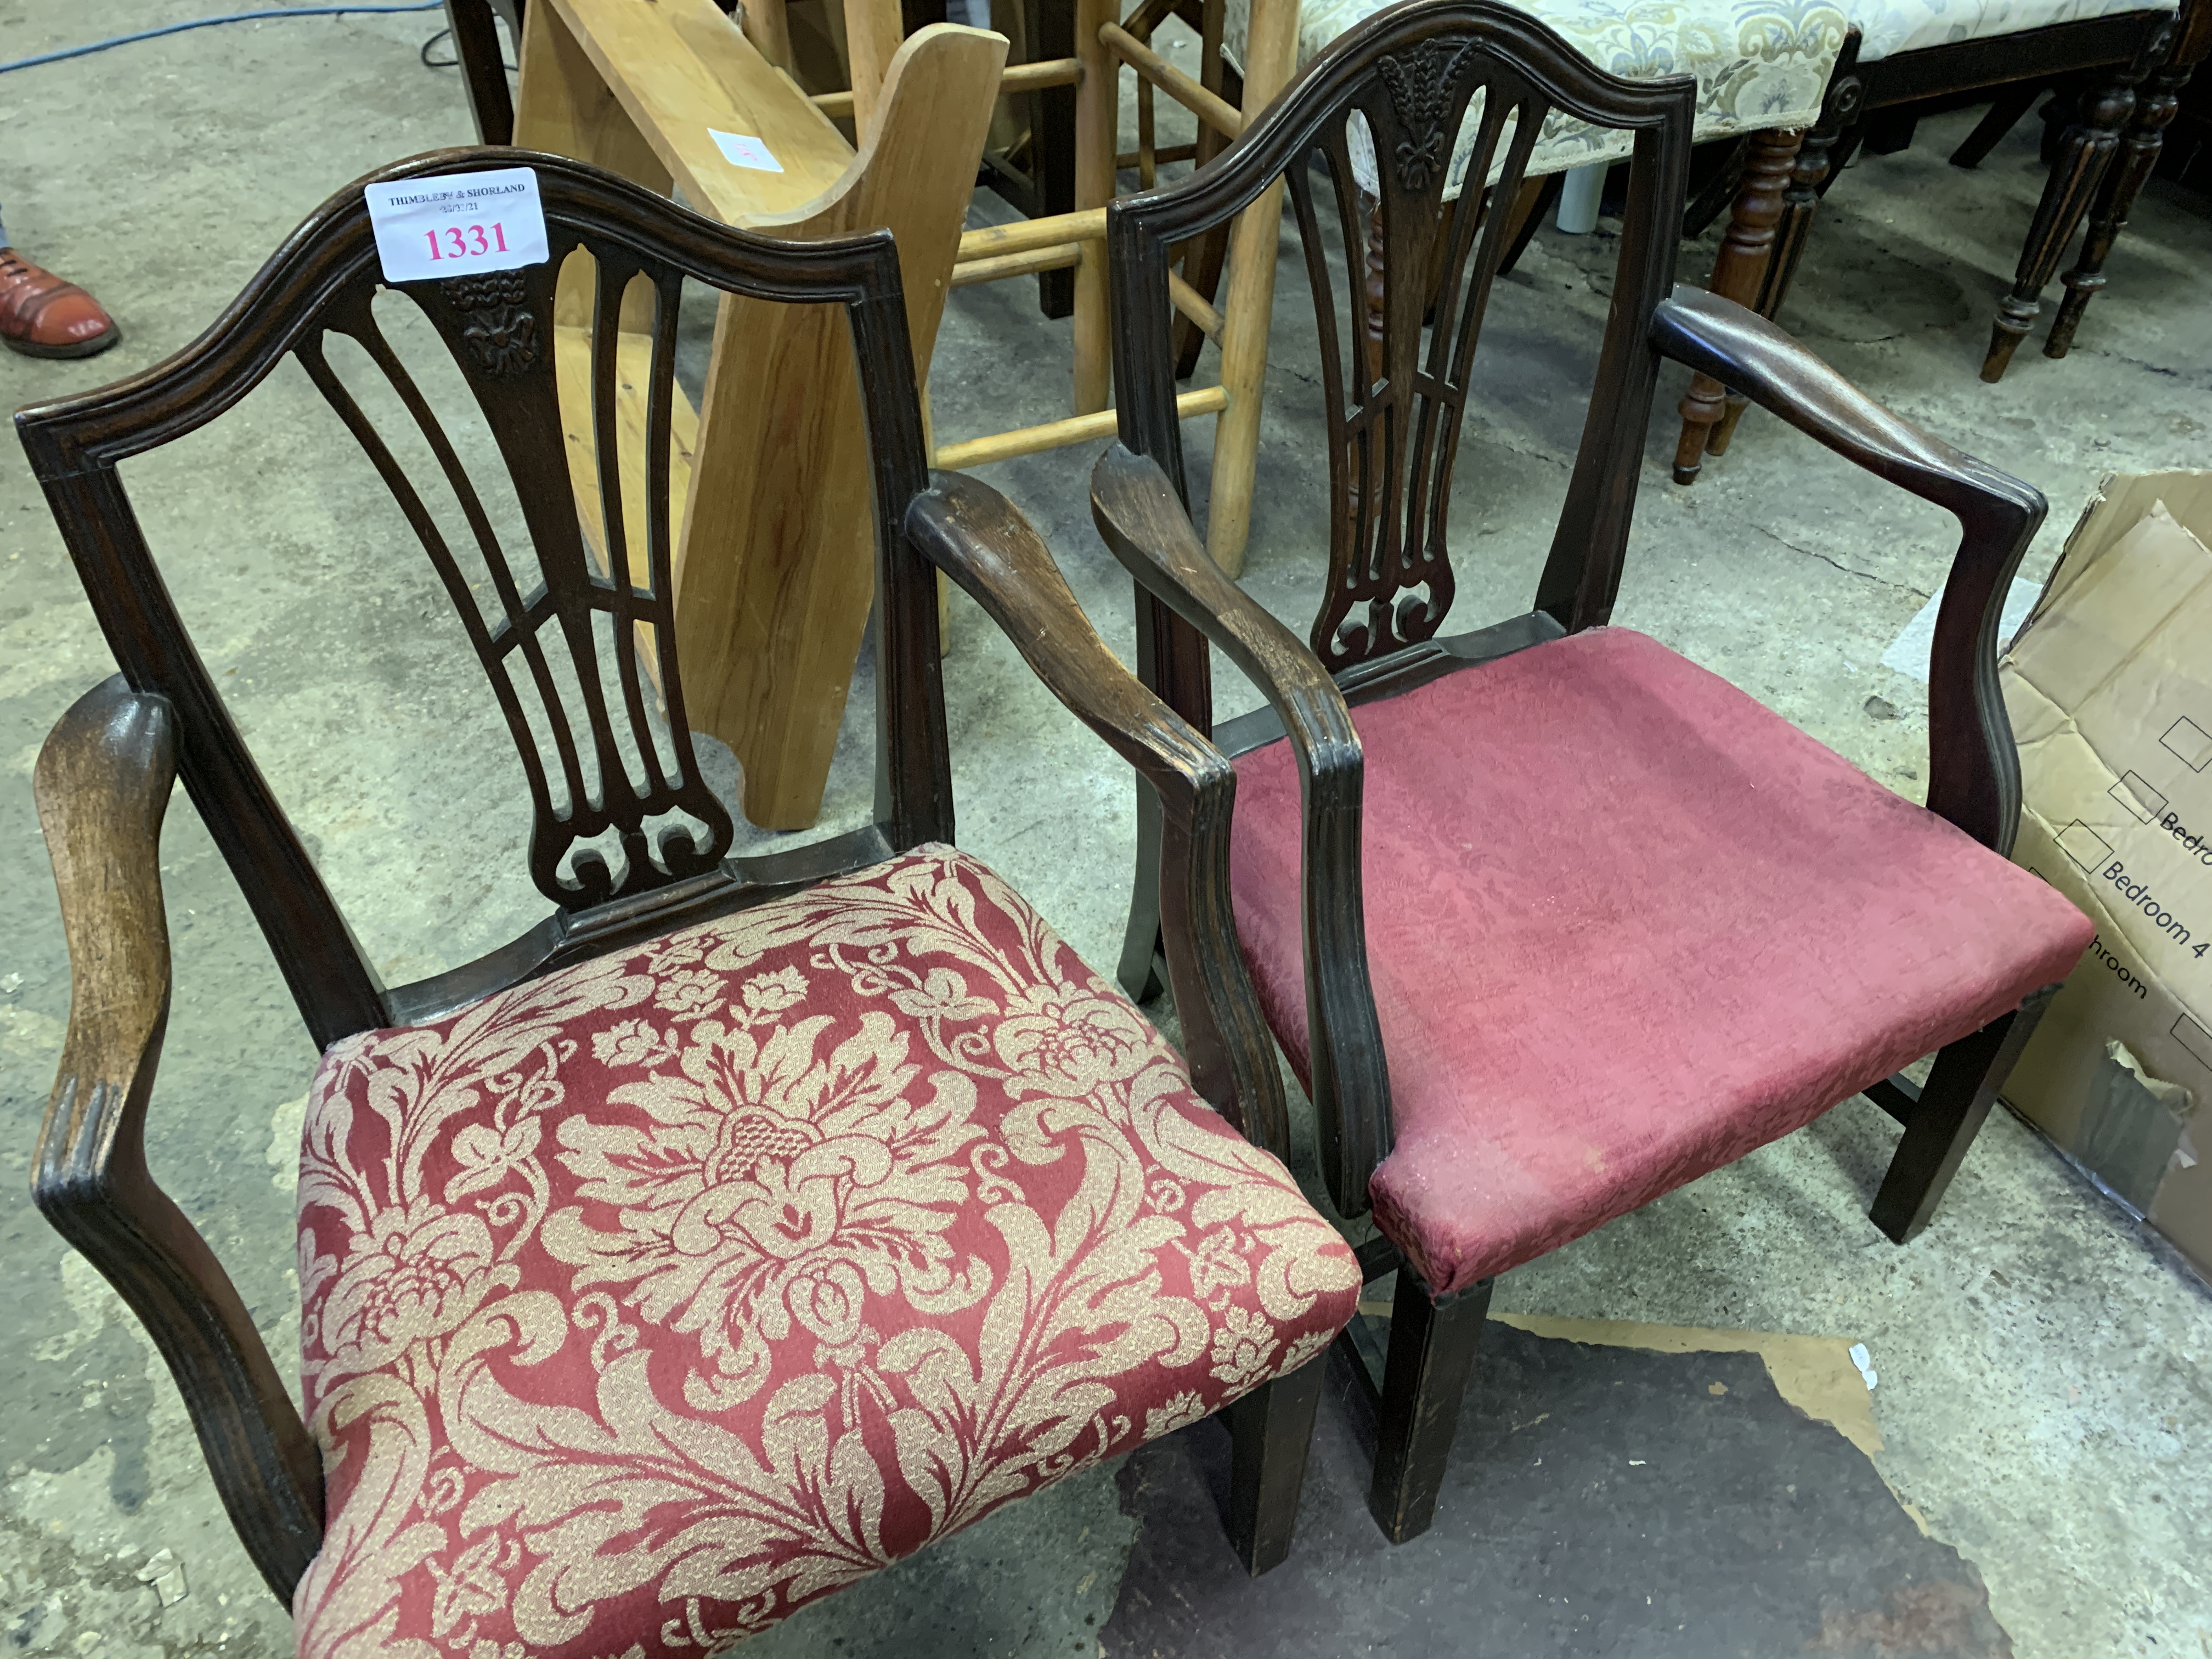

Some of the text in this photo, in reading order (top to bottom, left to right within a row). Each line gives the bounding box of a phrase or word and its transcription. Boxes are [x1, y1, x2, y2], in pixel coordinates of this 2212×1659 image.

[388, 184, 525, 206] THIMBLEBY & SHORLAND
[424, 222, 510, 260] 1331
[2103, 861, 2210, 958] Bedroom 4
[2089, 934, 2147, 1000] hroom
